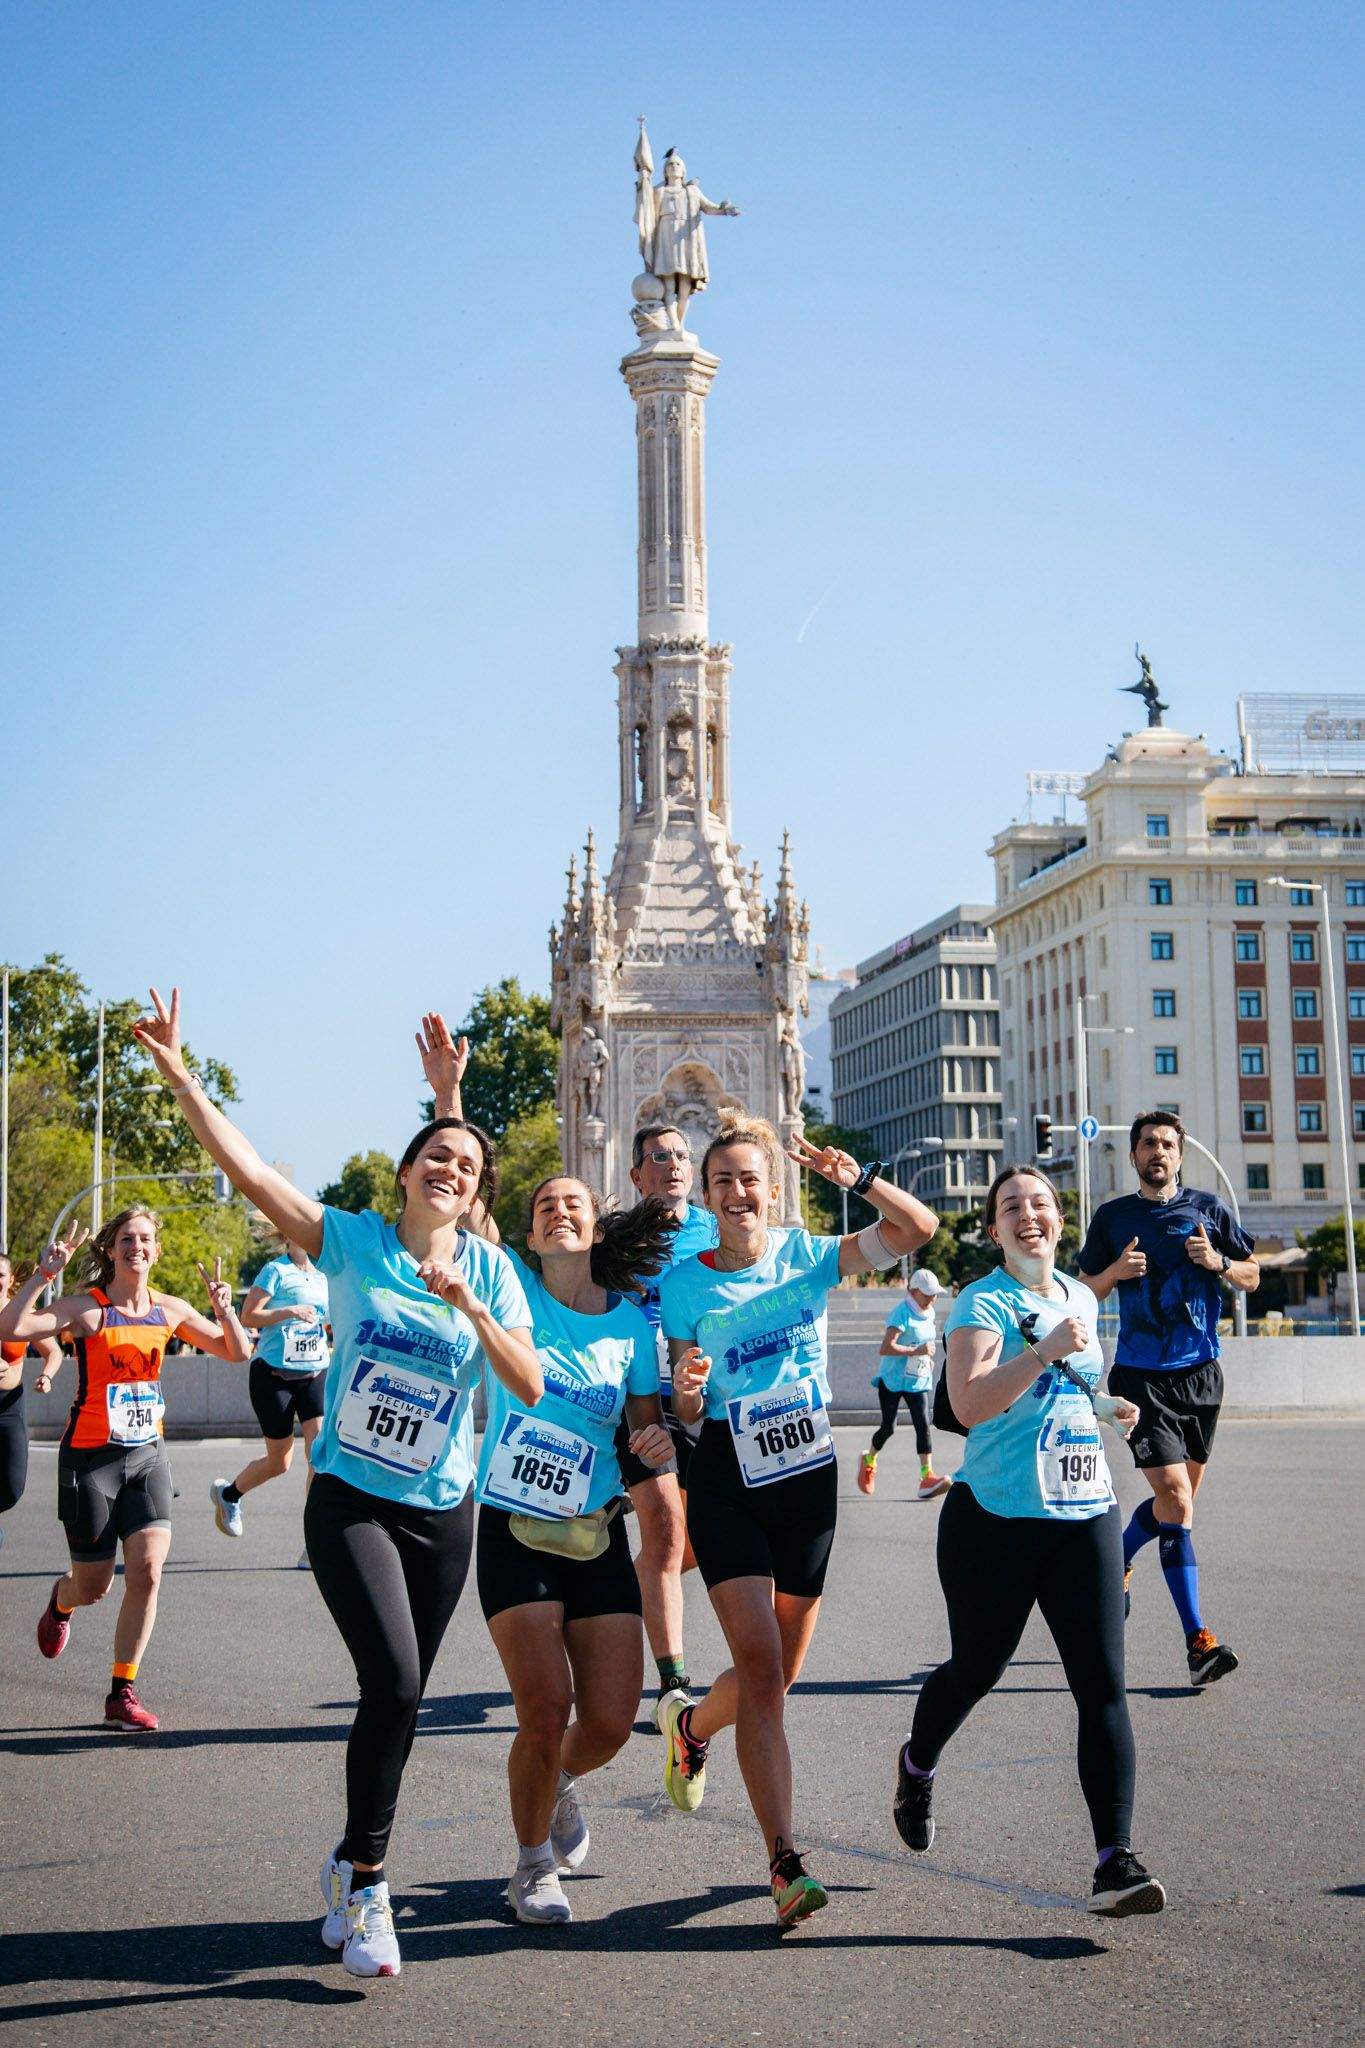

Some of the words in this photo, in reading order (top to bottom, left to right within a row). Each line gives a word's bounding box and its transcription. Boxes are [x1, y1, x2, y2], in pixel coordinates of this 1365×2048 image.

[701, 1283, 813, 1334] DECIMAS
[385, 1324, 466, 1357] BOMBEROS
[745, 1320, 814, 1350] BOMBEROS
[788, 1329, 817, 1348] MADRID
[411, 1345, 424, 1357] de
[388, 1380, 438, 1403] BOMBEROS
[564, 1389, 576, 1402] de
[577, 1394, 612, 1417] MADRID
[761, 1393, 806, 1412] BOMBEROS
[127, 1408, 152, 1427] 254
[376, 1393, 431, 1419] DECIMAS
[759, 1407, 809, 1429] DECIMAS
[366, 1404, 423, 1447] 1511
[754, 1417, 815, 1457] 1680
[525, 1445, 576, 1469] DECIMAS
[536, 1433, 580, 1455] BOMBEROS
[511, 1454, 573, 1496] 1855
[1058, 1454, 1097, 1482] 1931
